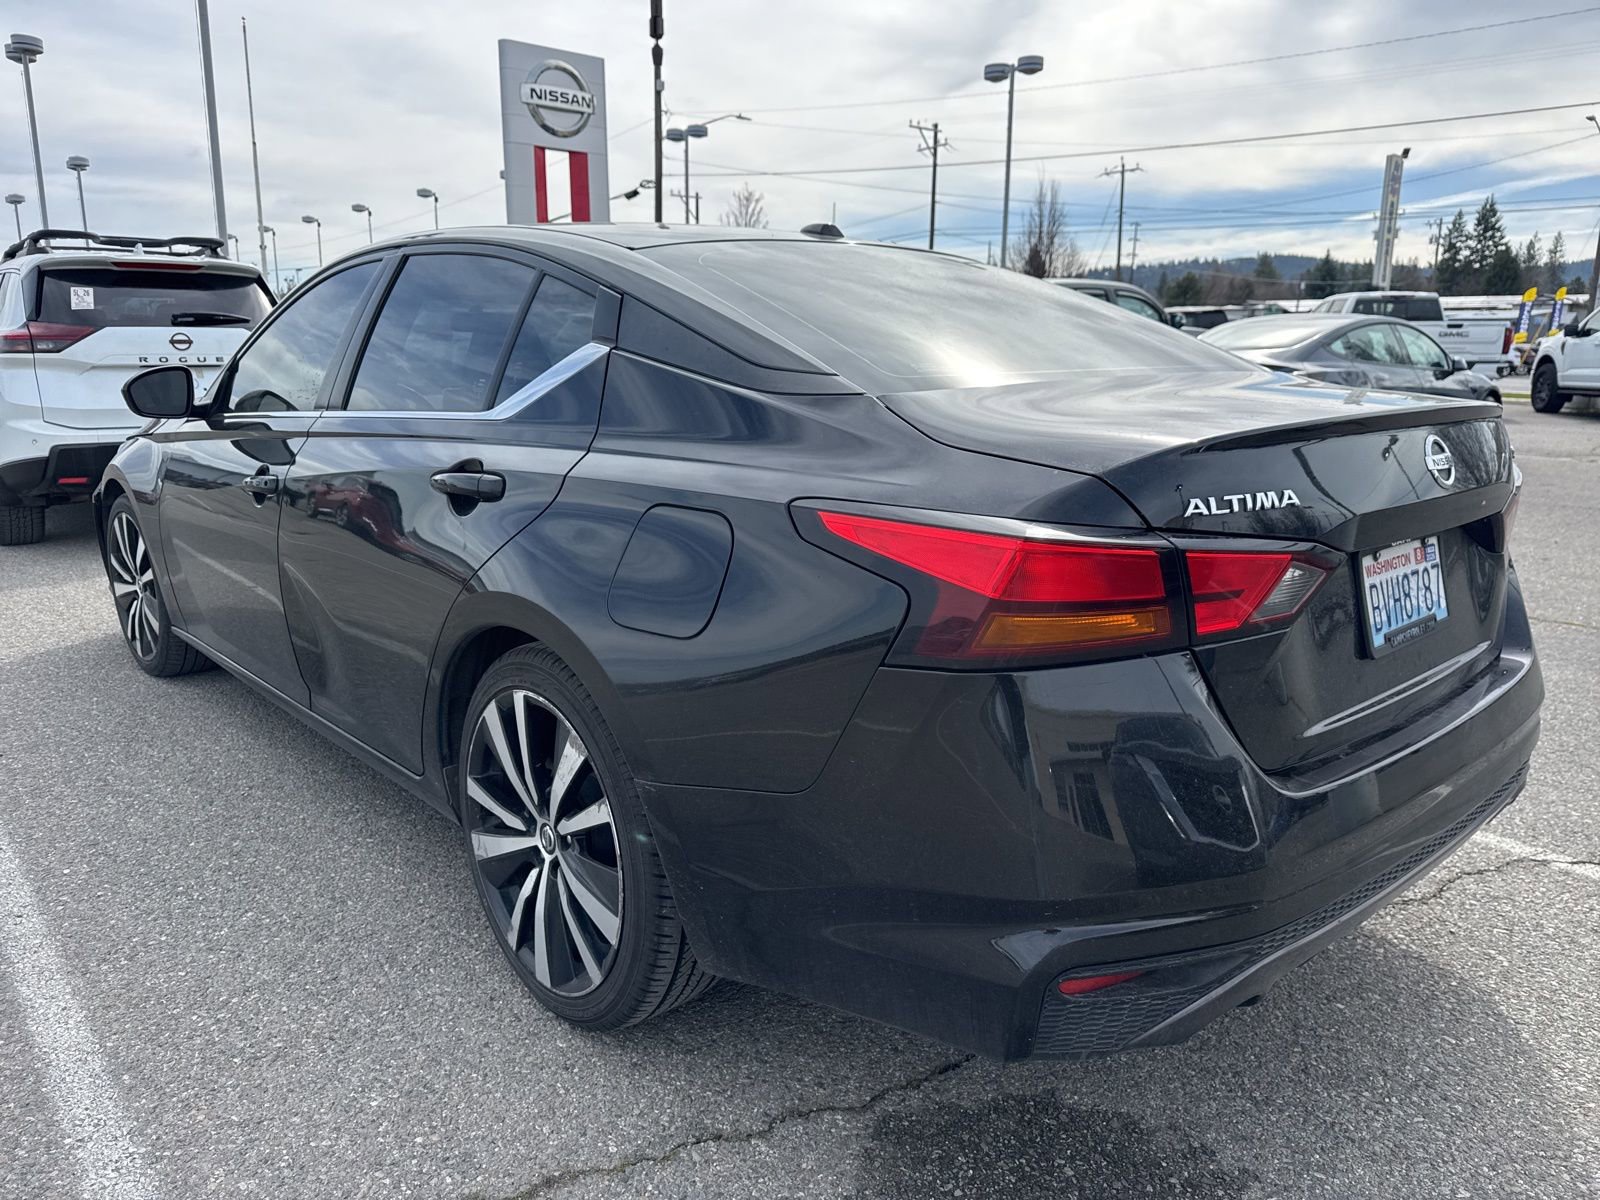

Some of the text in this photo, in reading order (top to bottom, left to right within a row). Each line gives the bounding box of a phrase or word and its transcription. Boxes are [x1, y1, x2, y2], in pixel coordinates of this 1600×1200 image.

[530, 87, 592, 109] NISSAN
[1183, 489, 1300, 518] ALTIMA
[1364, 552, 1411, 579] WASHINGTON
[1368, 562, 1441, 633] BVH8787
